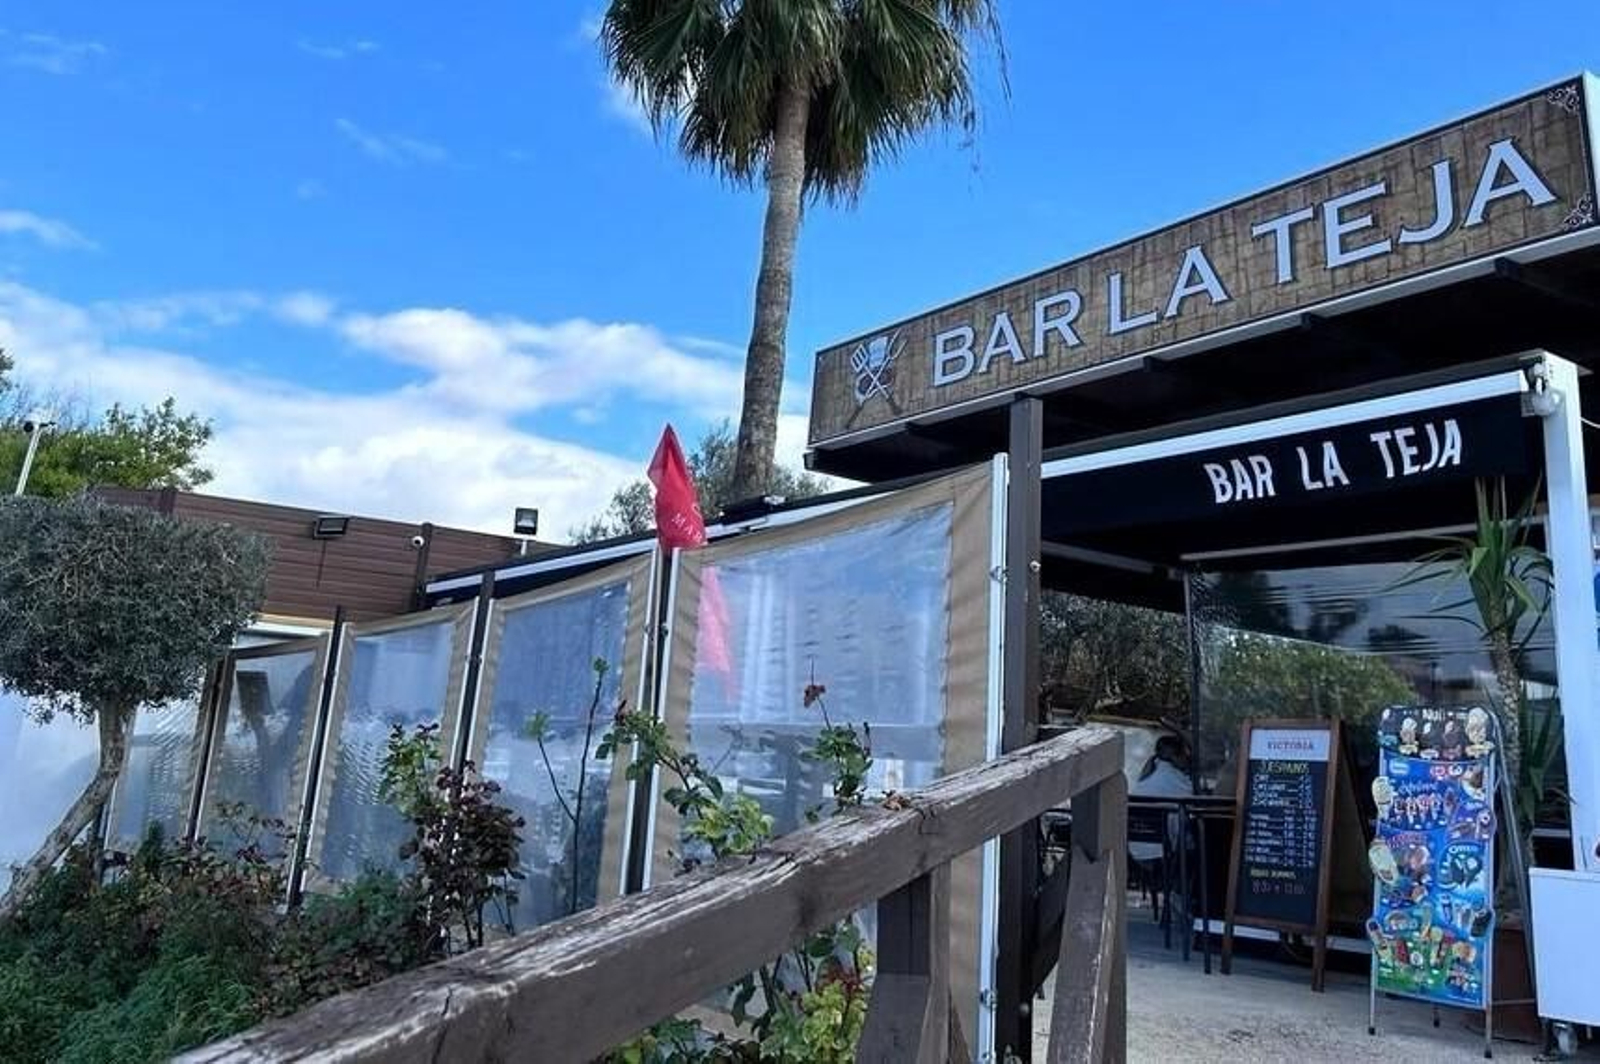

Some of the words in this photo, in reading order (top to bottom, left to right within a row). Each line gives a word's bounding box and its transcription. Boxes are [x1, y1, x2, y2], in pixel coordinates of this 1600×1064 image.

[933, 291, 1081, 387] BAR
[1109, 245, 1228, 334] LA
[1252, 139, 1556, 284] TEJA
[1204, 456, 1276, 504] BAR
[1299, 442, 1349, 489] LA
[1370, 418, 1462, 479] TEJA
